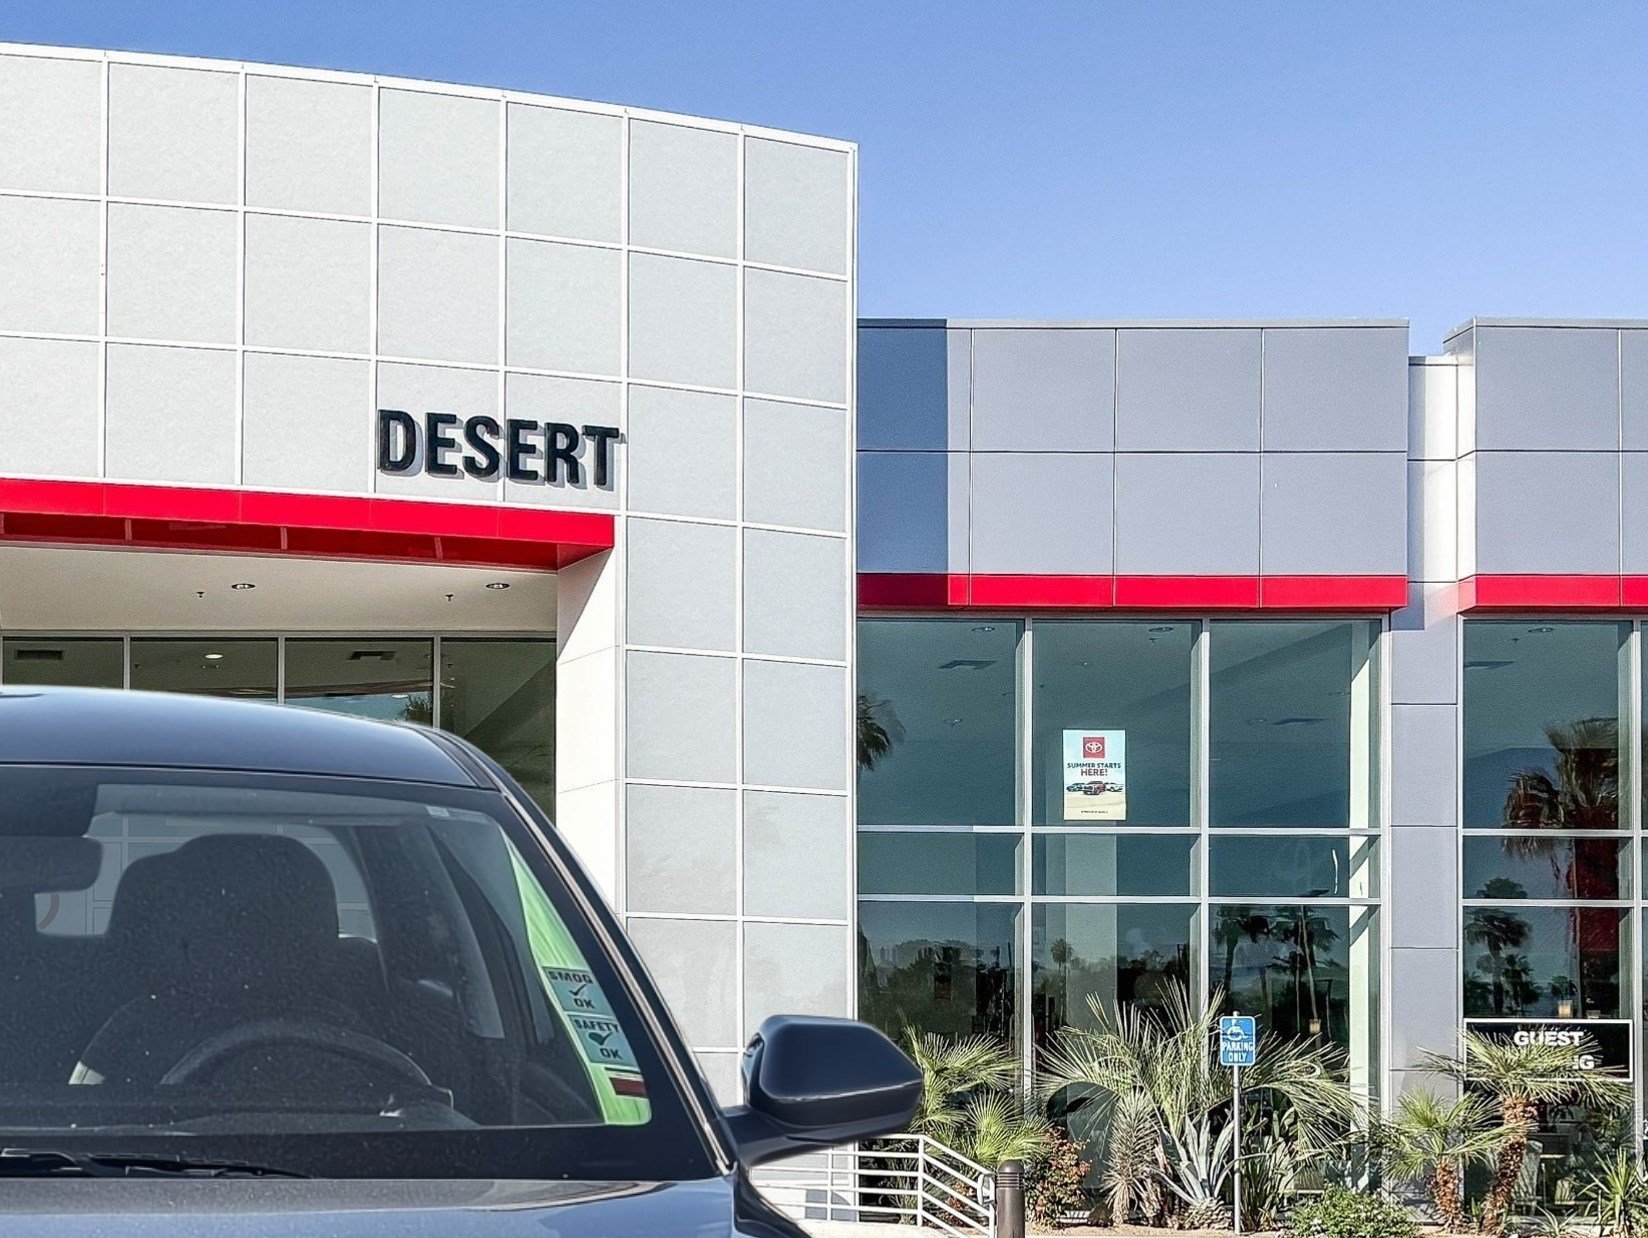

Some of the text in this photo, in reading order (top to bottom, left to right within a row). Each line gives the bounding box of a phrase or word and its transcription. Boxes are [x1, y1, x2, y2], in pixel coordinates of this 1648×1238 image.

[377, 409, 620, 487] DESERT
[549, 970, 593, 984] SMOG
[574, 998, 596, 1009] OK
[573, 1019, 620, 1032] SAFETY
[1513, 1030, 1585, 1047] GUEST
[1222, 1041, 1254, 1052] PARKING
[599, 1047, 622, 1060] OK
[1228, 1052, 1248, 1063] ONLY
